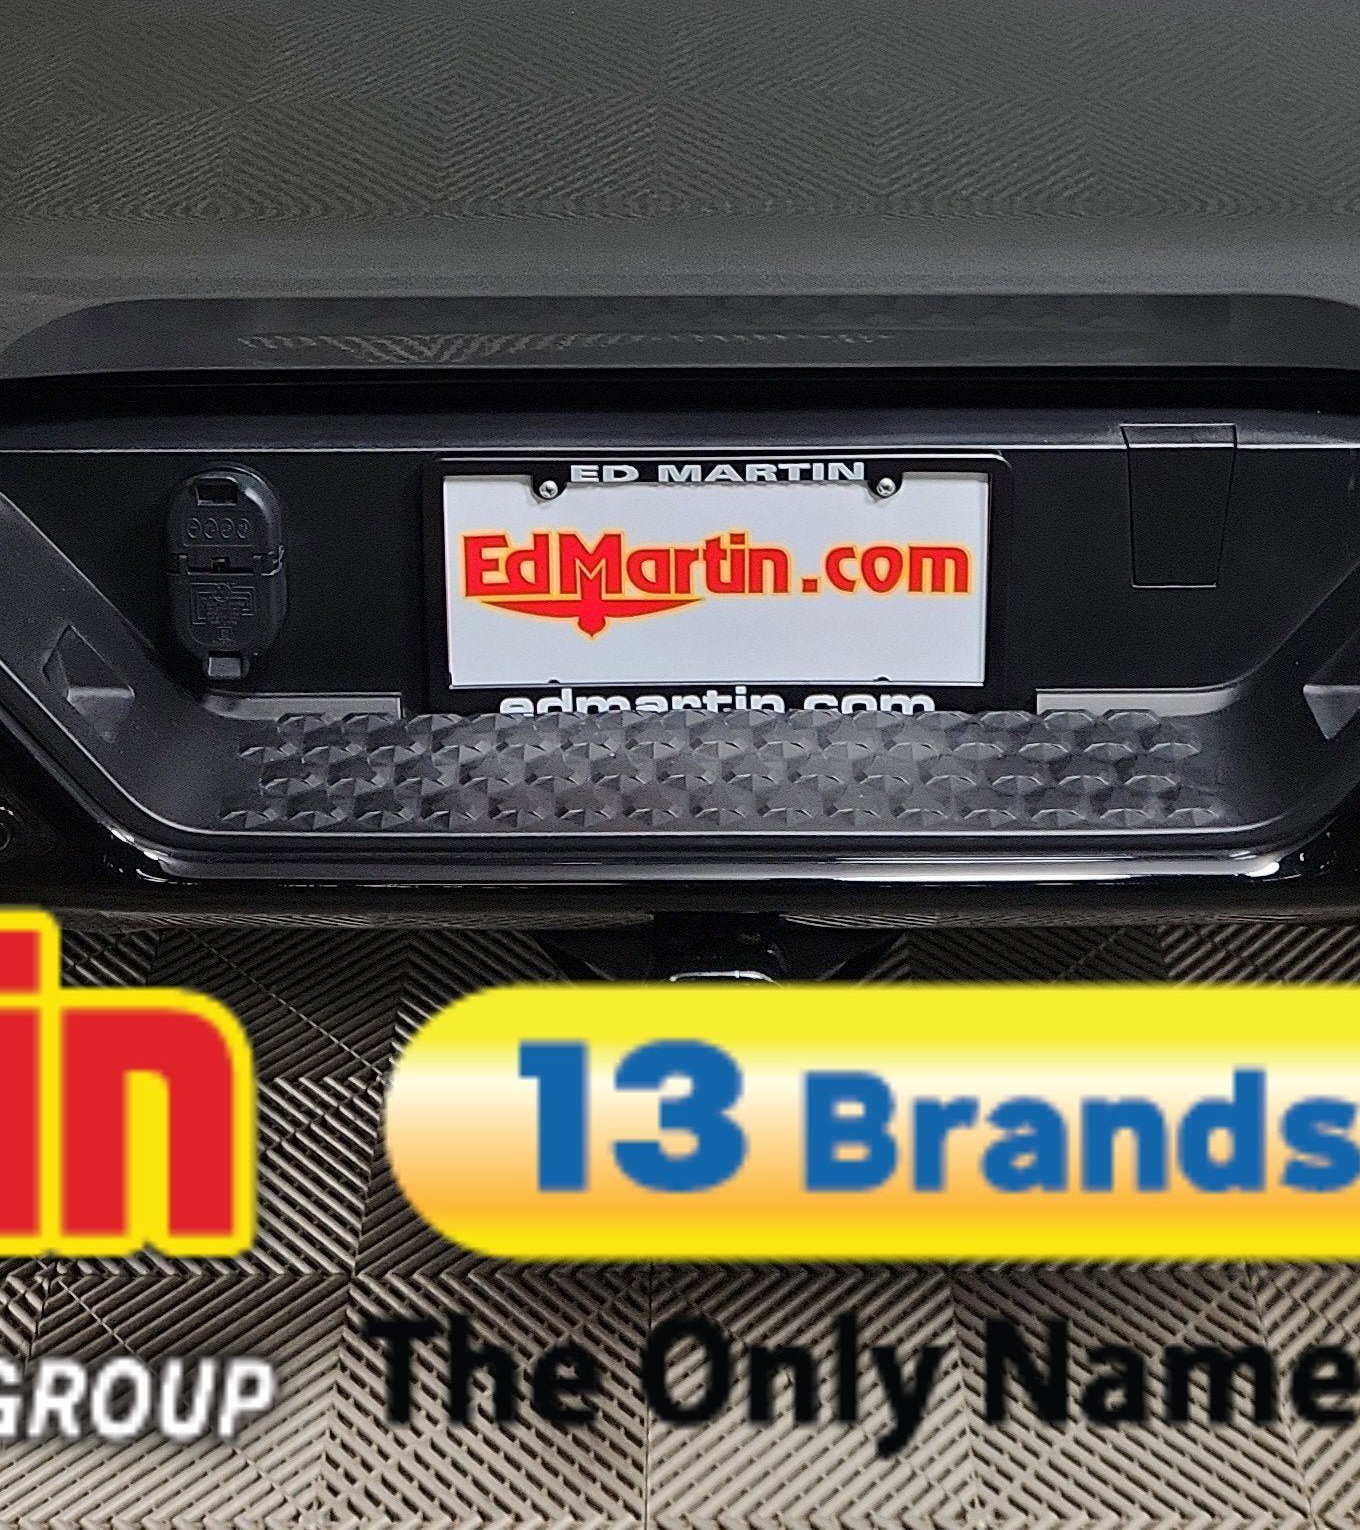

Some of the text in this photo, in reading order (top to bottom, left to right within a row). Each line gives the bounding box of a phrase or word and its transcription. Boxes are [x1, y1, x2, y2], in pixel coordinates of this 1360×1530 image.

[569, 461, 866, 484] ED MARTIN
[499, 685, 936, 716] edmartincom
